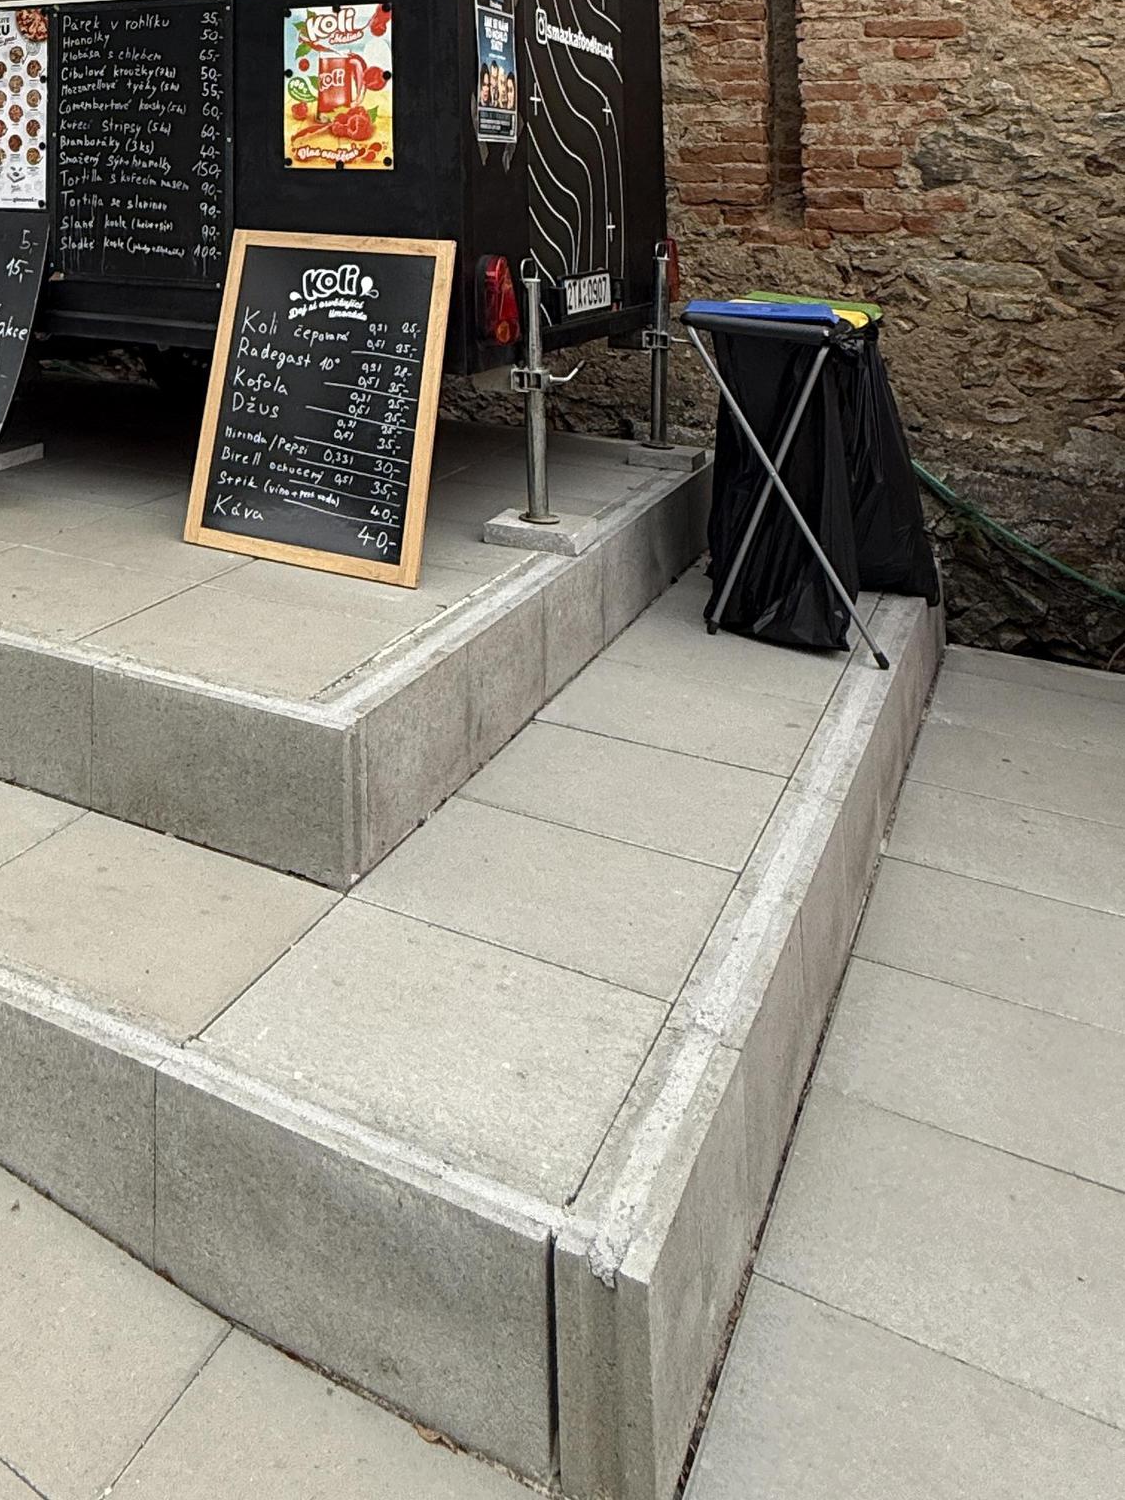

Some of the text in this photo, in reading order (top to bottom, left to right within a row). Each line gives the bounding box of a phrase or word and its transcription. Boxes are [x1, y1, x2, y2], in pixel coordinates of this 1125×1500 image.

[63, 15, 99, 33] Párek
[111, 20, 119, 30] v
[125, 13, 170, 30] rohlíku
[305, 7, 356, 42] Koli
[63, 32, 110, 49] Hranolky
[547, 23, 614, 60] smazkafoodtruck
[62, 49, 100, 63] Klobása
[108, 50, 114, 59] s
[118, 47, 162, 61] chlebem
[61, 65, 106, 81] Cibulové
[60, 135, 120, 153] Bramboráky
[59, 168, 102, 187] Tortilla
[60, 190, 104, 208] Tortilla
[303, 264, 361, 301] Koli
[241, 306, 278, 335] Koli
[237, 337, 311, 369] Radegast
[233, 366, 288, 395] Kofola
[232, 392, 279, 418] Džus
[221, 446, 261, 466] Birell
[269, 461, 324, 485] ochucený
[213, 494, 264, 521] Káva
